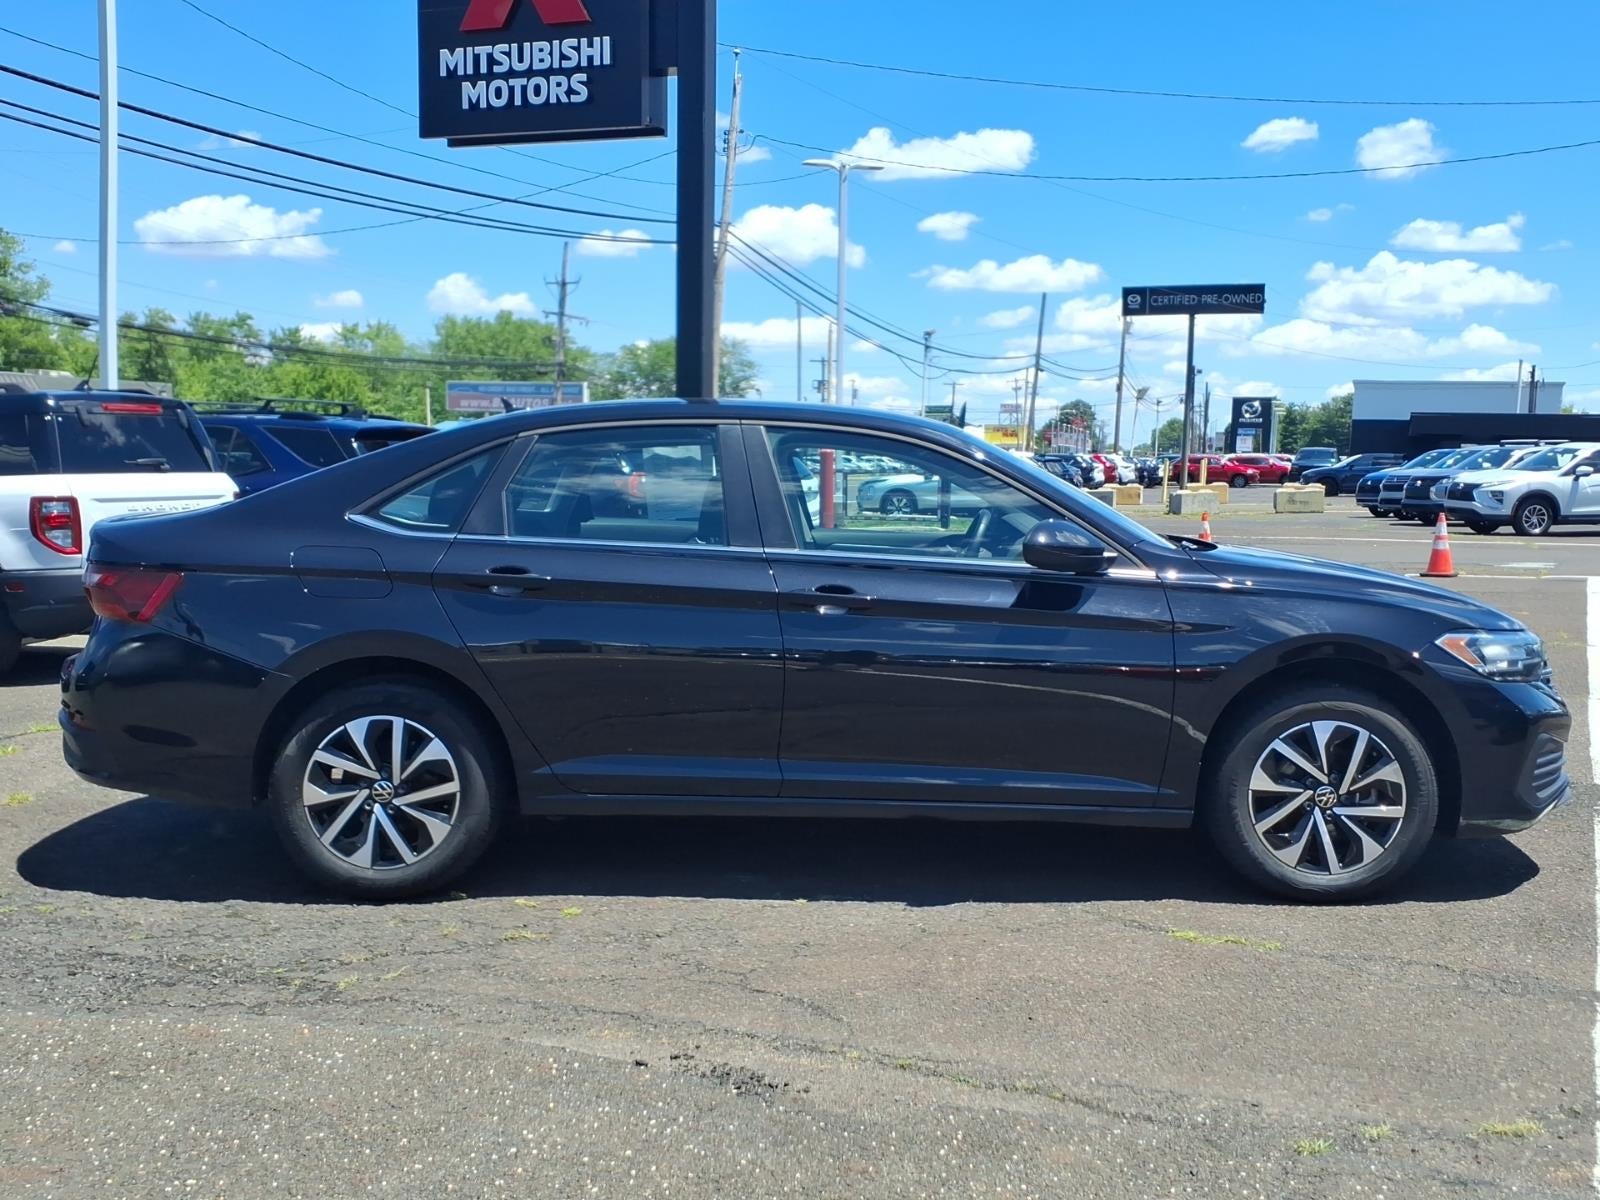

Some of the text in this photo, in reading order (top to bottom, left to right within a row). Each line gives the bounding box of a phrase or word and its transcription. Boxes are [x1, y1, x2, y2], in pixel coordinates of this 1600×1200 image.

[439, 36, 610, 77] MITSUBISHI
[461, 73, 588, 109] MOTORS
[1150, 293, 1263, 306] CERTIFIED PRE-OWNED
